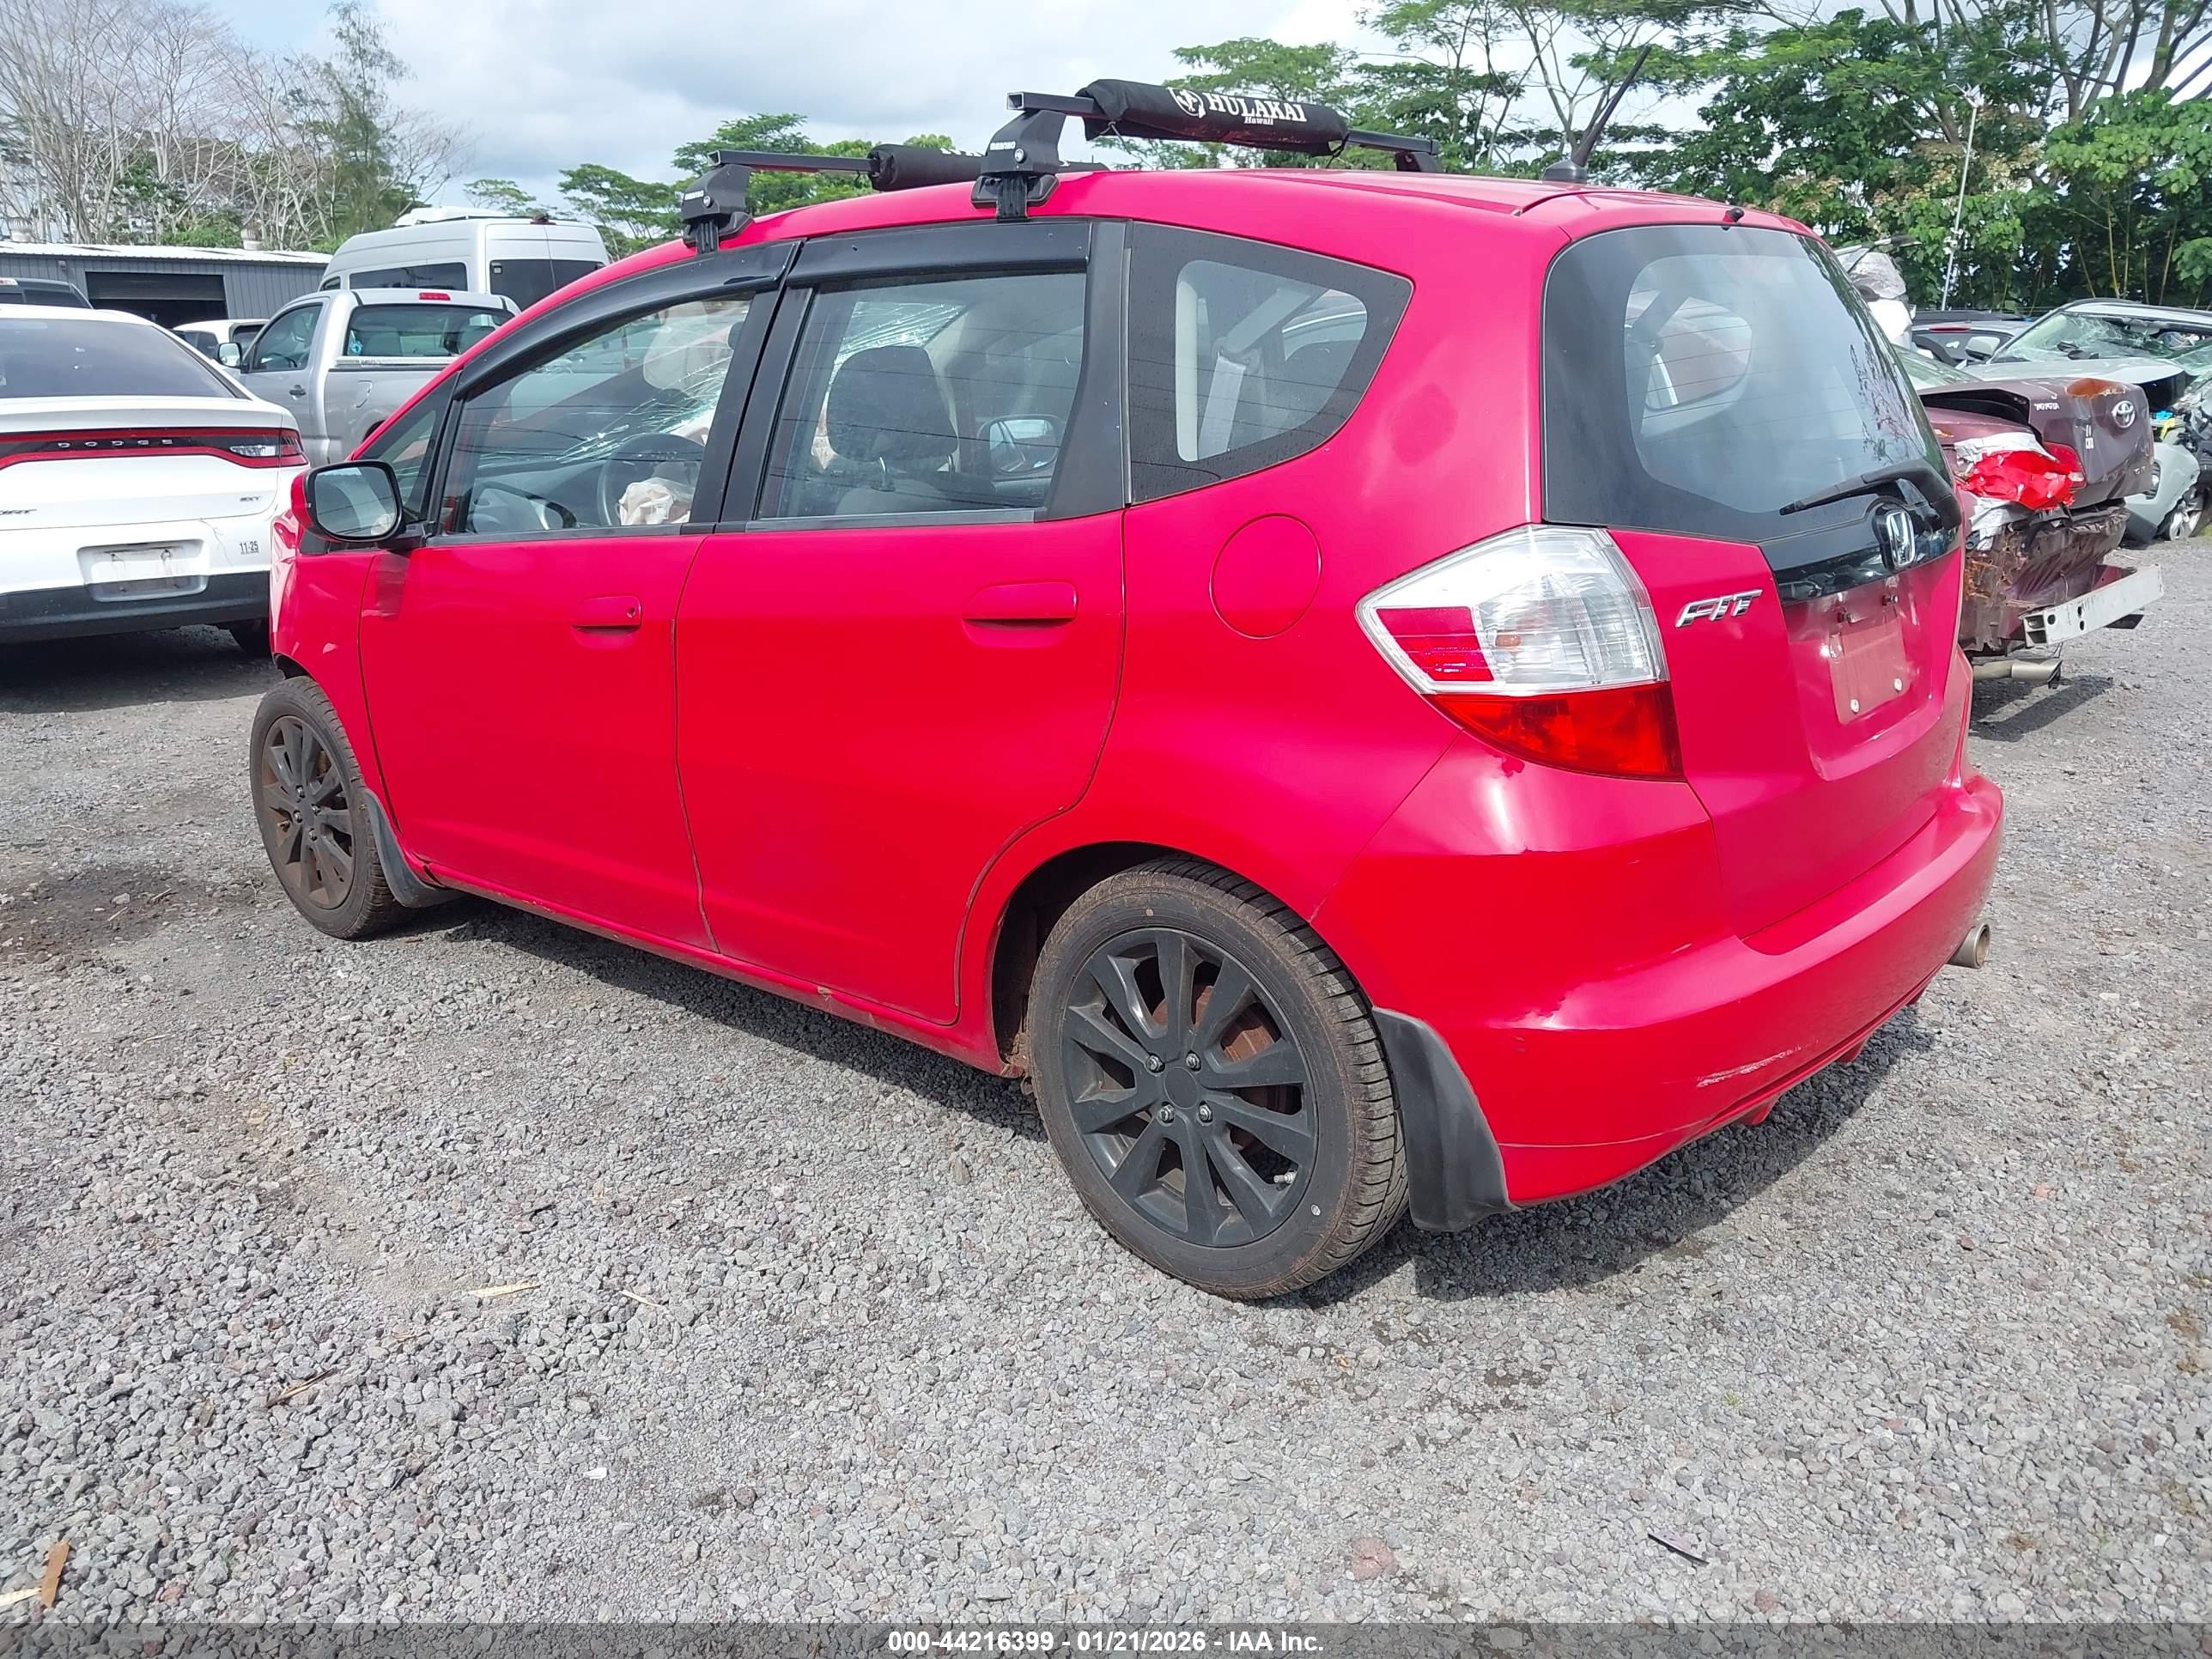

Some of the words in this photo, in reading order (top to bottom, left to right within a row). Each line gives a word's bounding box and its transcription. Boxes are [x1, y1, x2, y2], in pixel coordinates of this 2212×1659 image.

[1203, 92, 1308, 123] HULAKAI
[58, 439, 173, 448] DODGE
[1674, 589, 1763, 628] FIT
